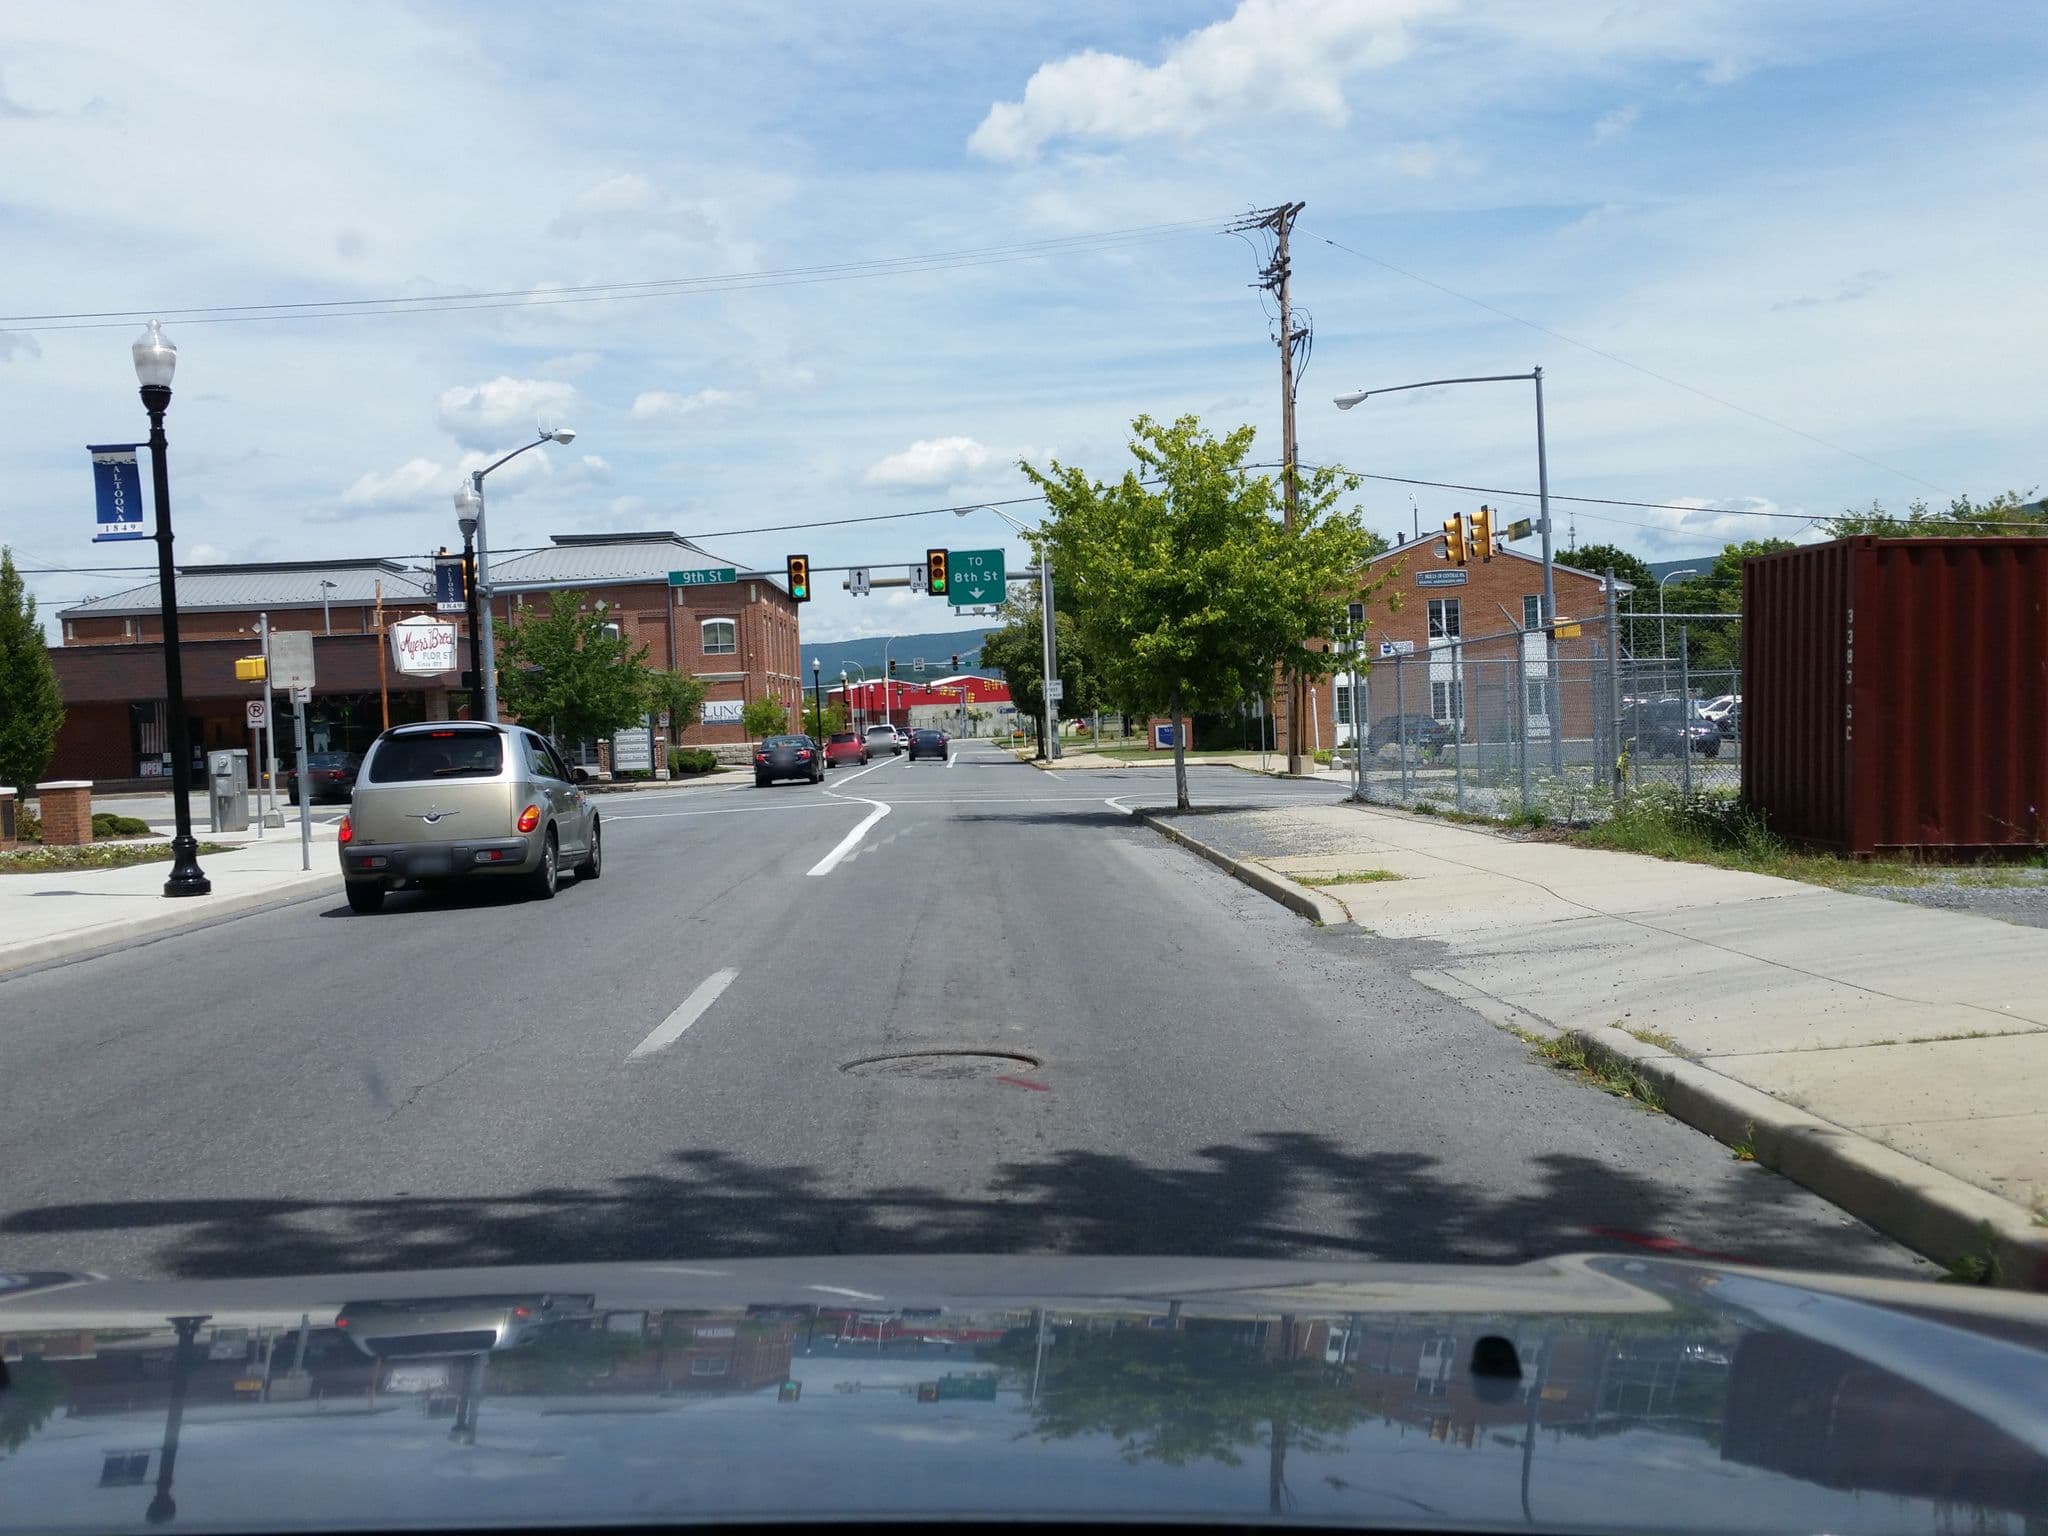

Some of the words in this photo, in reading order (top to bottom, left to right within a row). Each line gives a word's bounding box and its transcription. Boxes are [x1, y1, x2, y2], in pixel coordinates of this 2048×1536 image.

[113, 465, 124, 522] ALTOONA
[105, 524, 136, 532] 1849
[968, 556, 983, 567] TO
[683, 571, 705, 584] 9th
[709, 570, 722, 582] St
[954, 571, 978, 583] 8th
[983, 570, 998, 582] St
[400, 631, 428, 660] Myers
[1846, 608, 1854, 684] 3383
